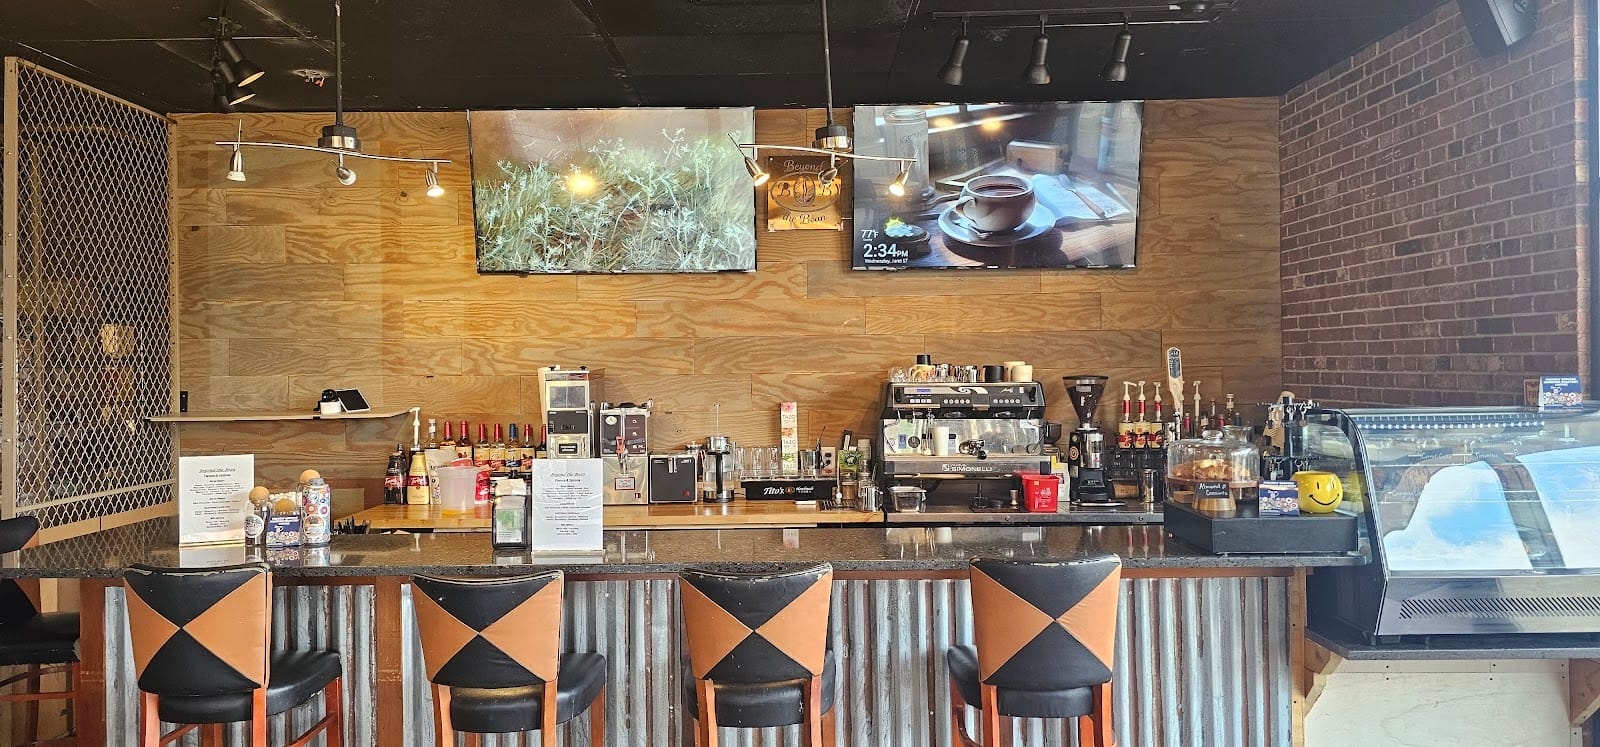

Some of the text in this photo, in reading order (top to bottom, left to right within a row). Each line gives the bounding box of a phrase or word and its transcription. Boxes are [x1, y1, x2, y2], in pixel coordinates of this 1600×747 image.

[784, 159, 825, 173] Beyond
[782, 212, 827, 224] the Bean
[763, 486, 785, 495] Tito's
